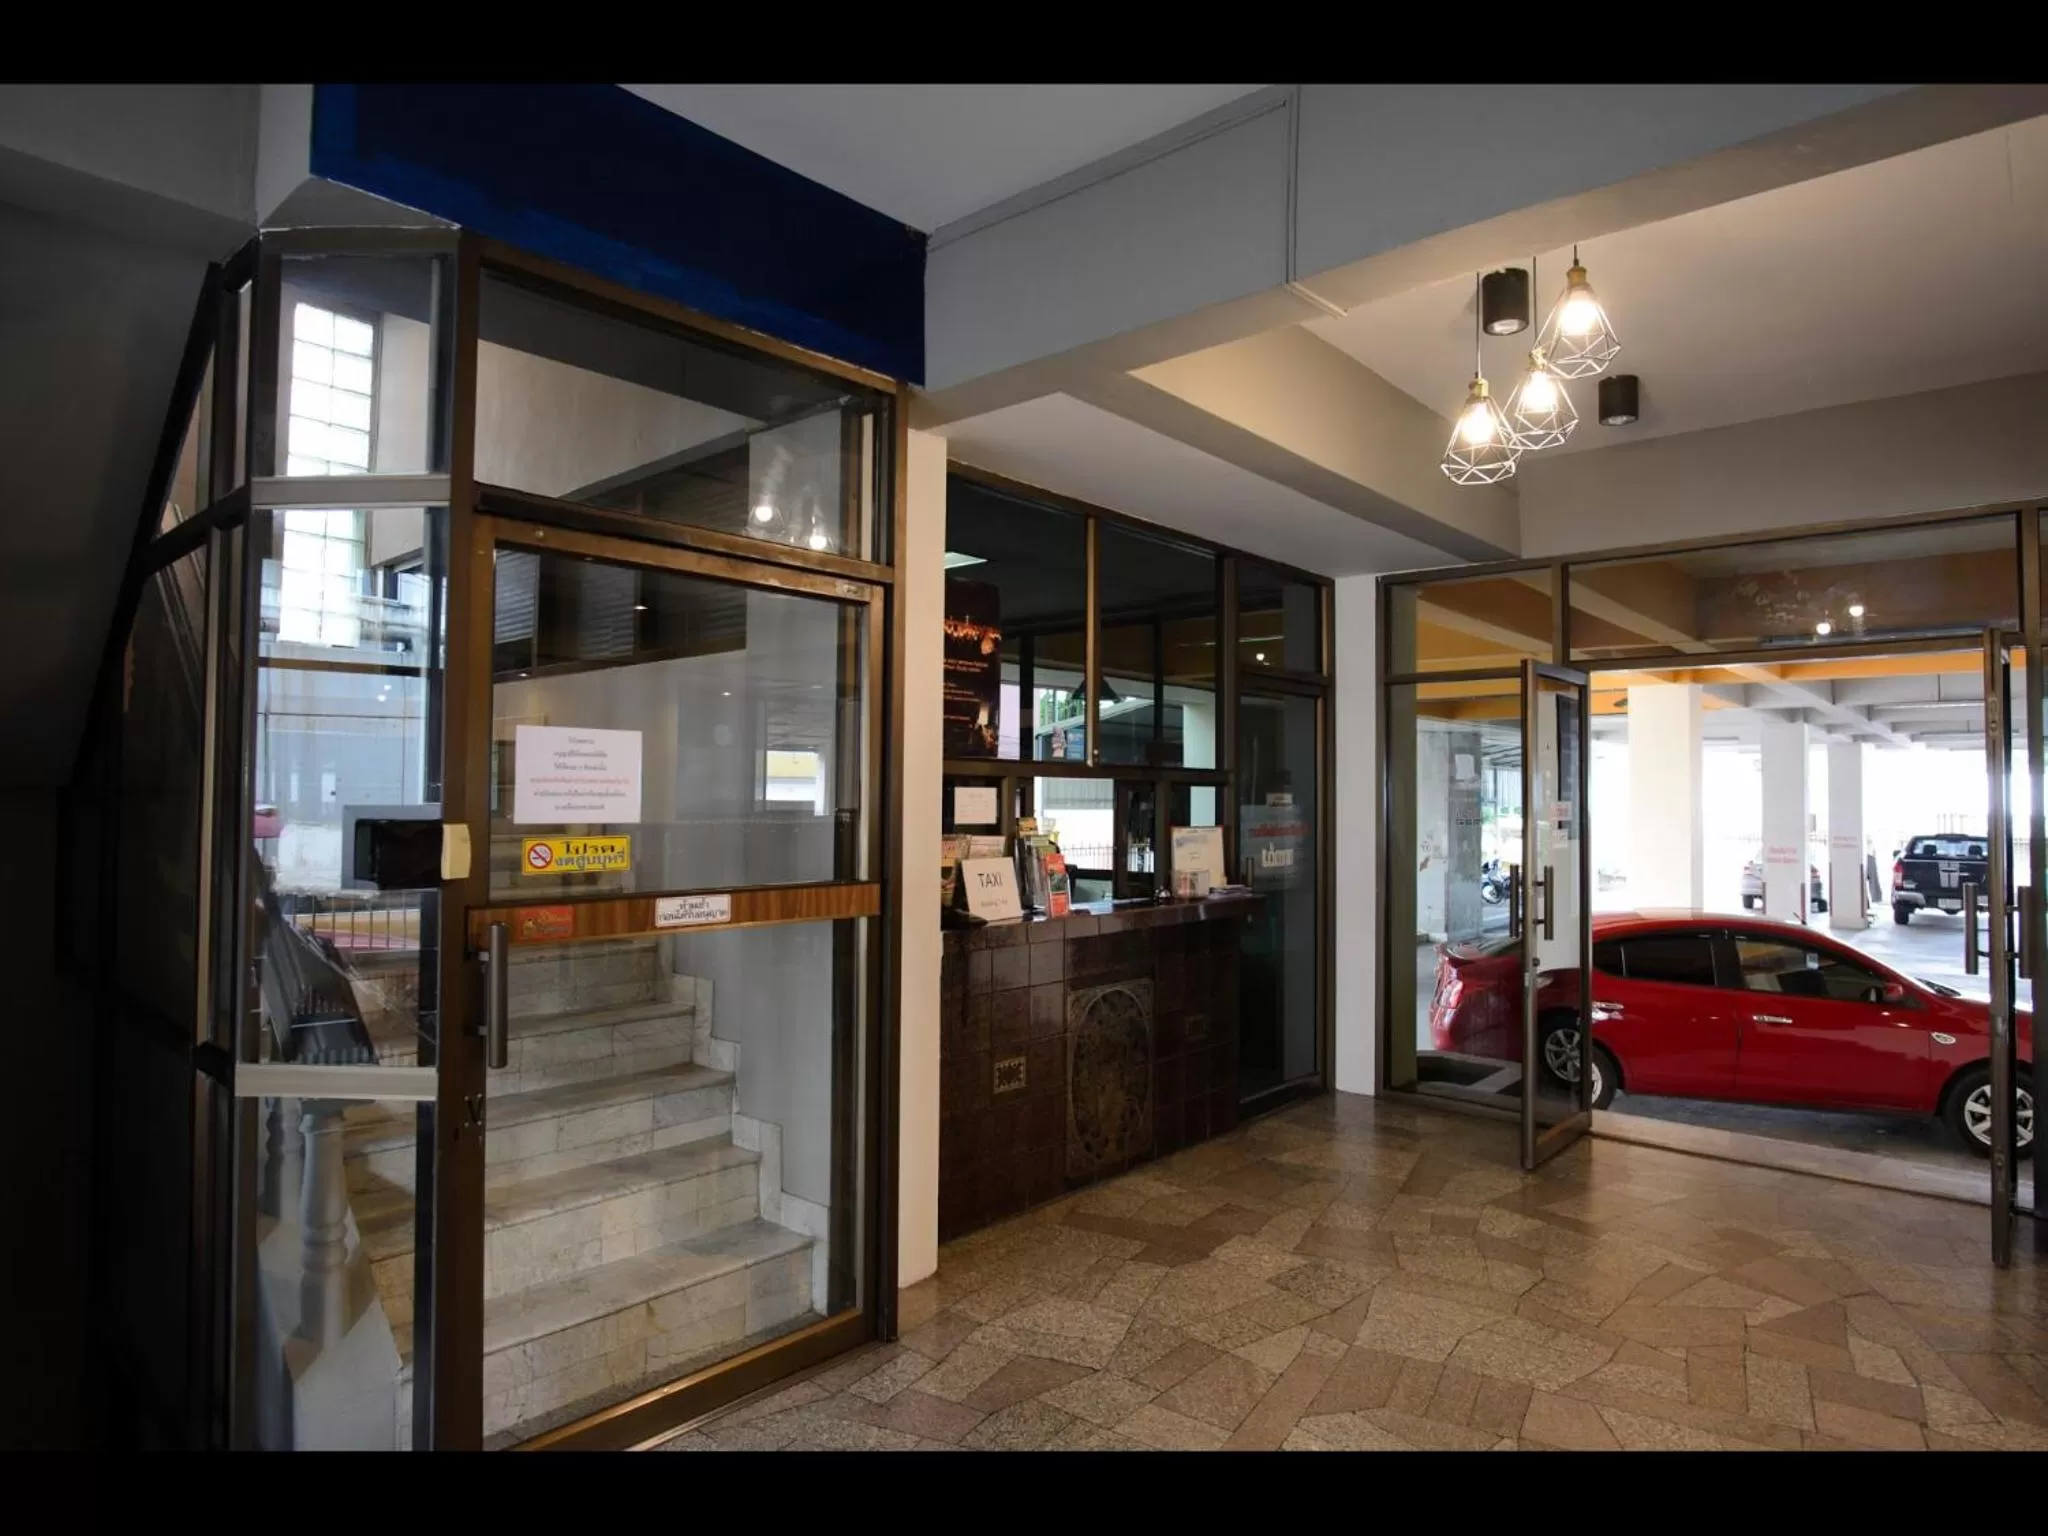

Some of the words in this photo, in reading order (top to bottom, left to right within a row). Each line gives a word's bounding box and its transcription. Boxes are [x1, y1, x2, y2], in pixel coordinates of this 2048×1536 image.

[560, 841, 615, 855] โปรด
[555, 847, 625, 870] งดสูบบุหรี่
[977, 872, 1003, 888] TAXI
